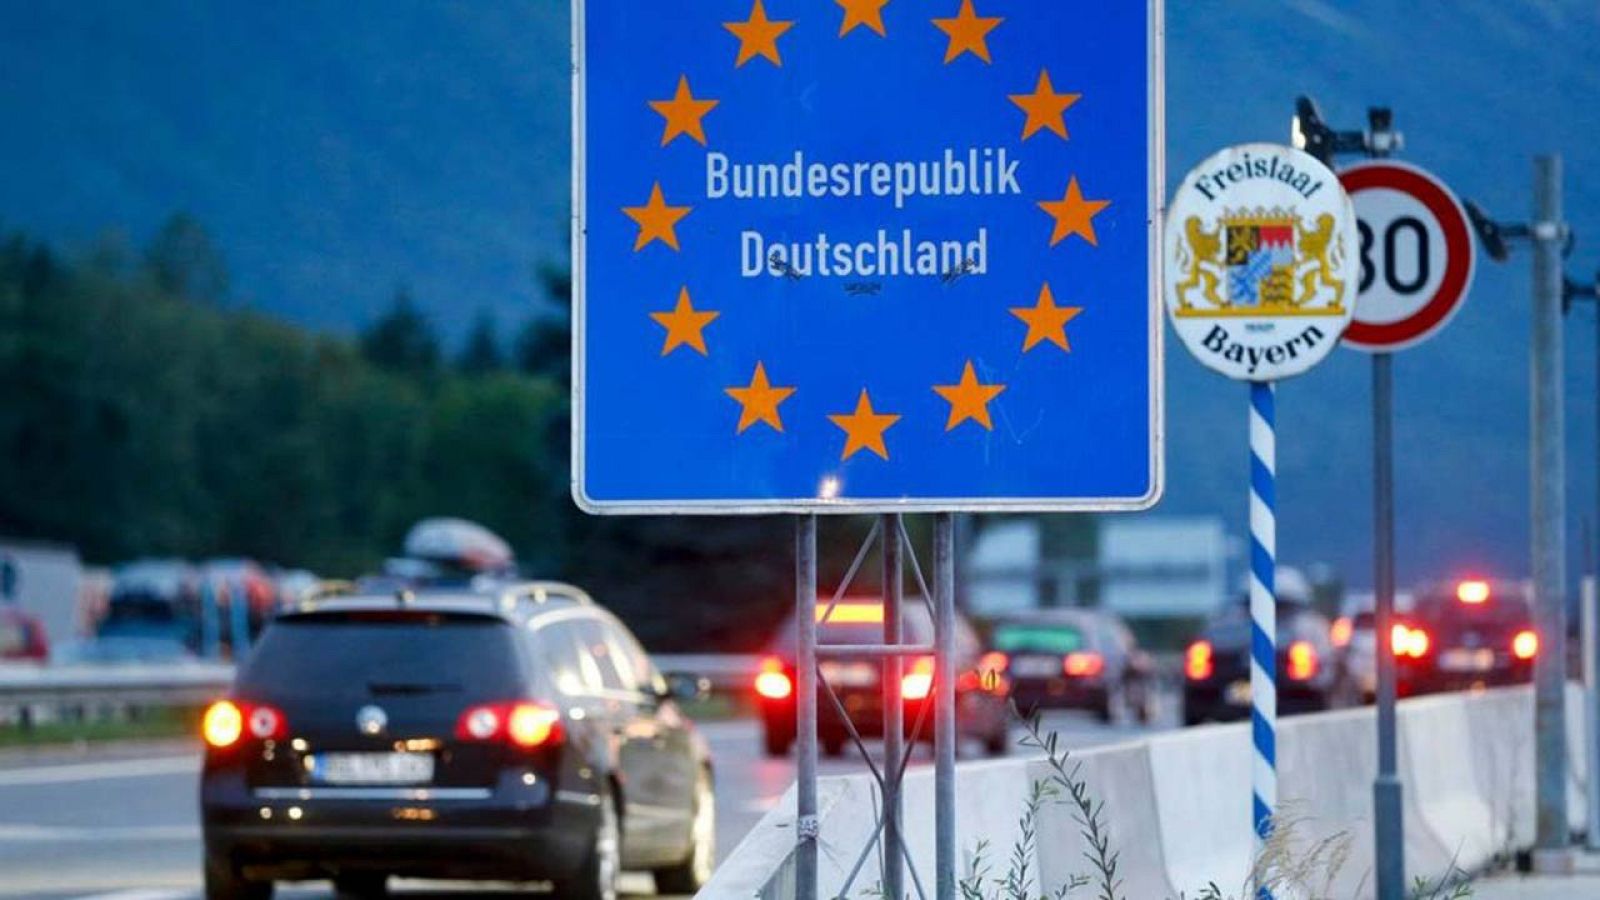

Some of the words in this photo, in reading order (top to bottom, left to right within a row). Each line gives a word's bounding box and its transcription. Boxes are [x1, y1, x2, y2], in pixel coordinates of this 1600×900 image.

[706, 148, 1021, 209] Bundesrepublik
[1195, 153, 1324, 202] Freistaat
[741, 228, 988, 278] Deutschland
[1202, 324, 1325, 374] Bayern
